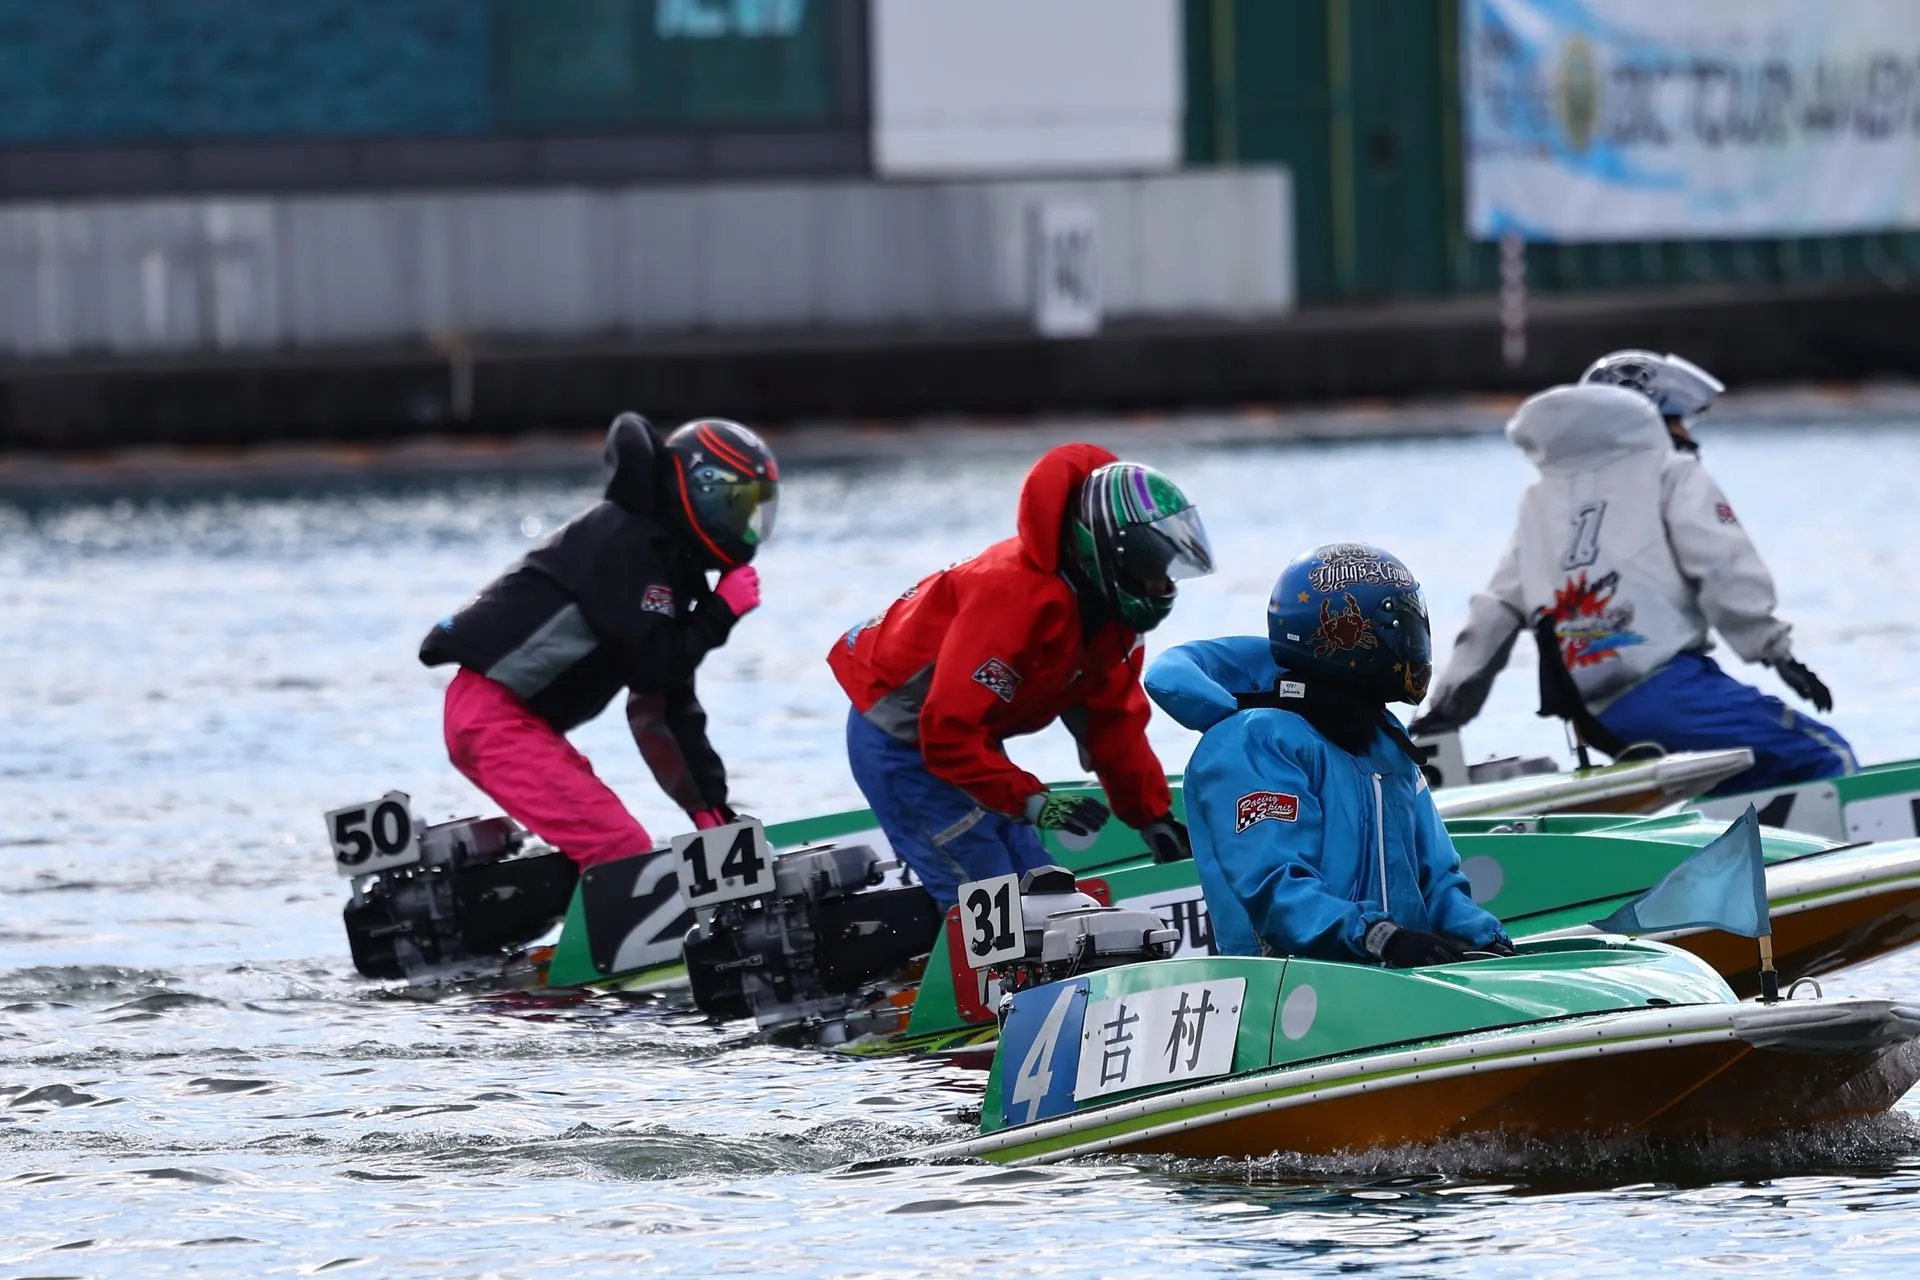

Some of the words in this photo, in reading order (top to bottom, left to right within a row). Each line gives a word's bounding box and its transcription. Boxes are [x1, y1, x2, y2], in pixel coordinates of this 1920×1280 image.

[1561, 501, 1607, 572] 1
[1309, 561, 1368, 593] Things
[335, 801, 411, 867] 50
[1240, 795, 1278, 815] Racing
[1256, 802, 1294, 817] Spirit
[683, 826, 765, 899] 14
[611, 851, 689, 974] 2
[966, 882, 1016, 957] 31
[1012, 984, 1078, 1123] 4
[1099, 987, 1215, 1088] 吉村
